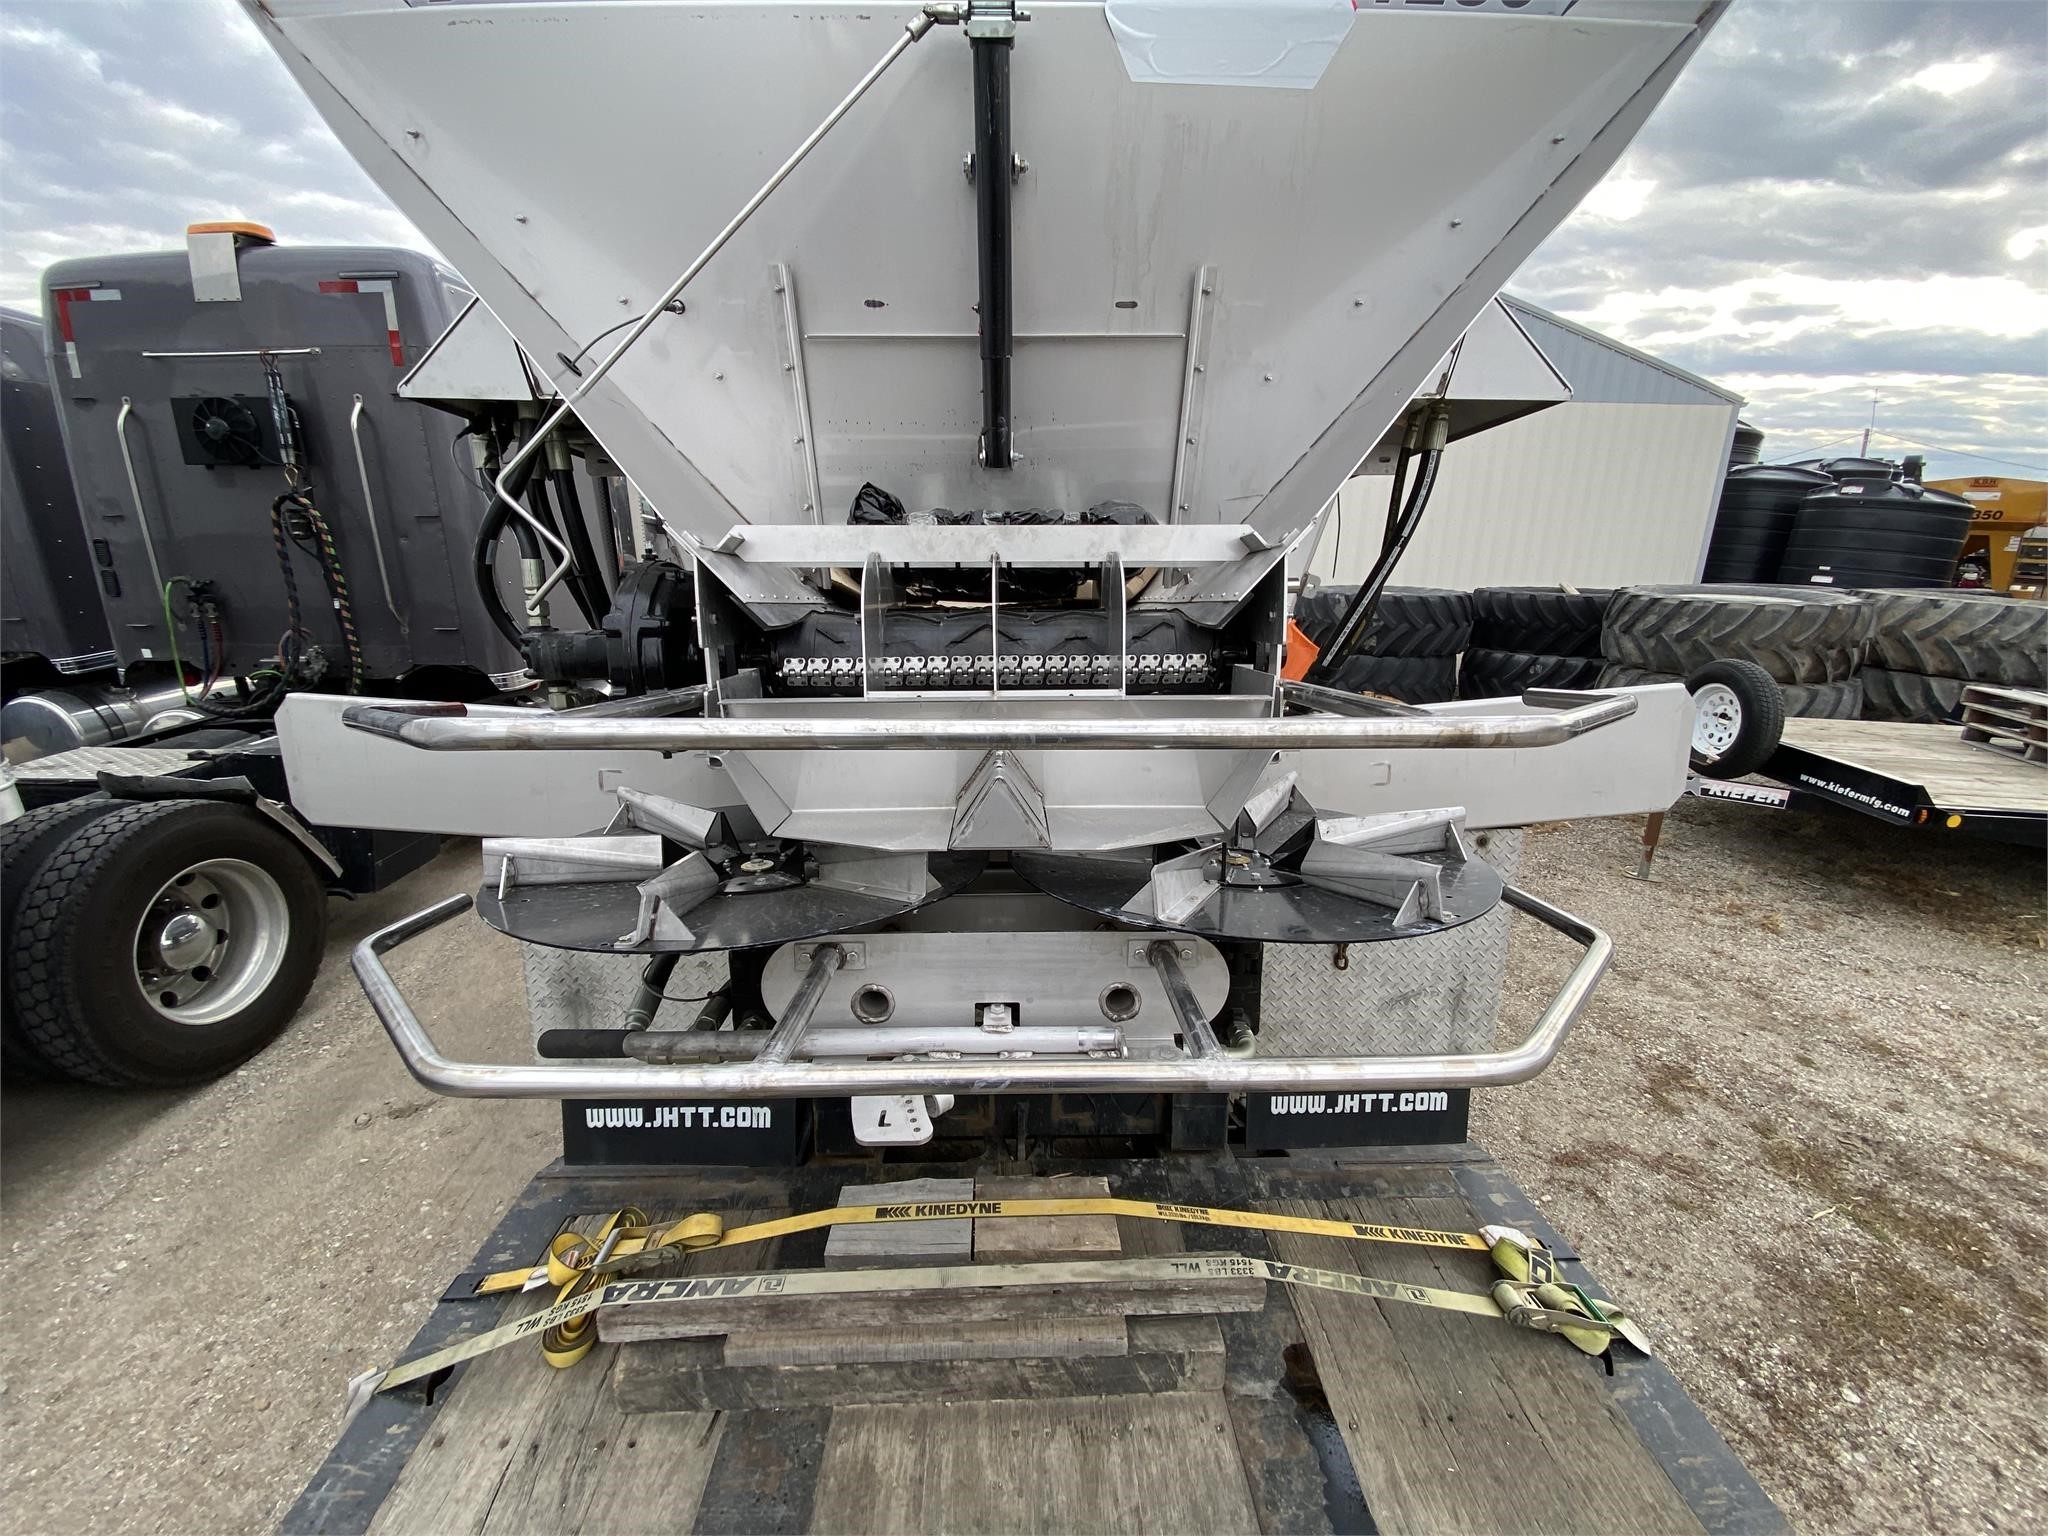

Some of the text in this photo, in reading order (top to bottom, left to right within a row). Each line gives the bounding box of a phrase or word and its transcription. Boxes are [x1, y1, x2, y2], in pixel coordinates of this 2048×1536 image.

[1706, 783, 1781, 805] KIEFER
[1800, 773, 1910, 818] www.kiefermfg.com
[915, 1202, 1001, 1217] KINEDYNE
[1173, 1206, 1210, 1215] KINEDYNE
[1388, 1227, 1470, 1246] KINEDYNE
[1170, 1262, 1201, 1273] WLL
[1207, 1267, 1255, 1276] 3333 LBS
[1230, 1258, 1253, 1267] 1515
[601, 1275, 758, 1304] ANCRA
[1264, 1262, 1401, 1298] ANCRA
[543, 1303, 588, 1327] 3333 LBS
[549, 1293, 594, 1317] 1515 KGS
[514, 1315, 544, 1336] WLL
